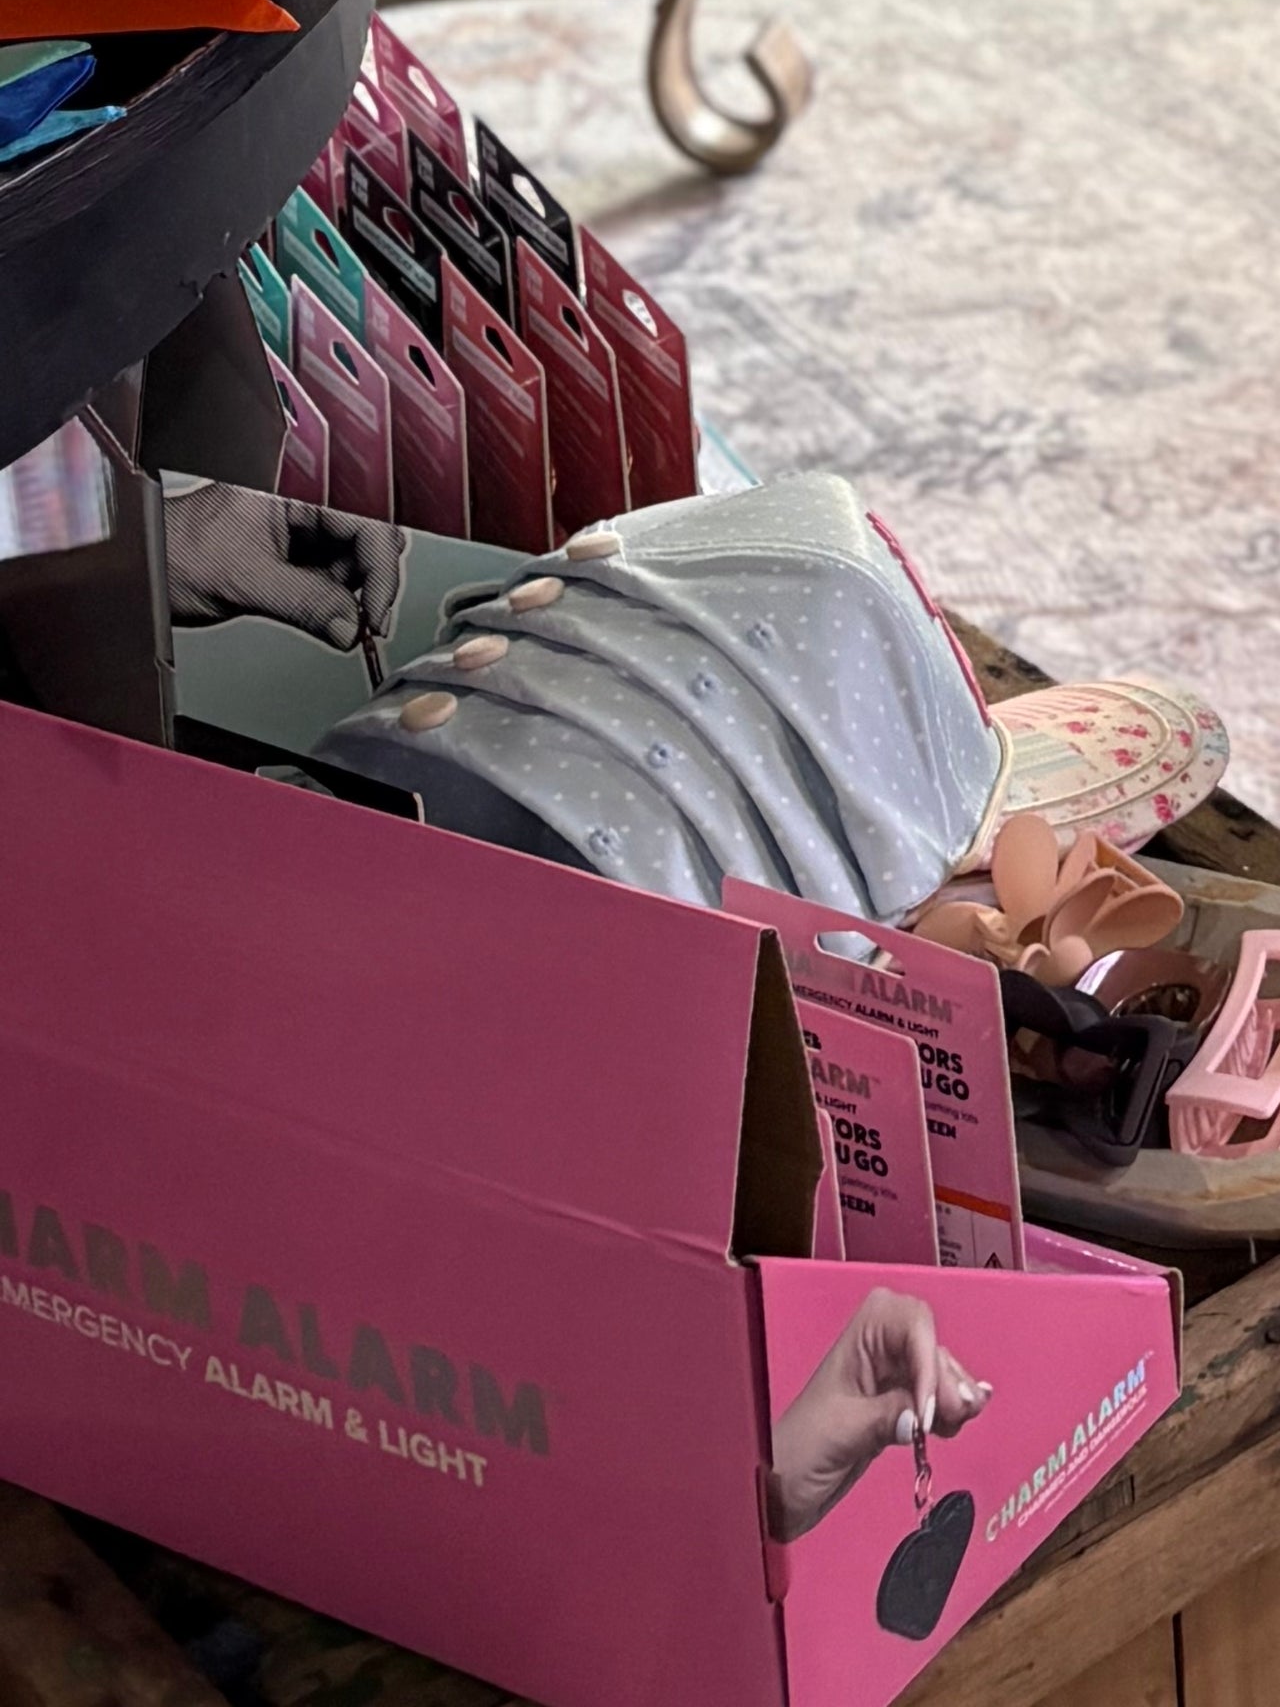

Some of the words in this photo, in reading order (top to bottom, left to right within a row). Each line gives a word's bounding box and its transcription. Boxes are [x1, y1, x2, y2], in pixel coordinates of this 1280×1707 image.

[792, 983, 853, 1011] MERGENCY
[855, 1003, 894, 1024] ALARM
[907, 1020, 940, 1039] LIGHT
[860, 972, 954, 1024] ALARM
[811, 1056, 872, 1100] ARM
[917, 1042, 964, 1075] ORS
[824, 1096, 858, 1115] LIGHT
[935, 1073, 969, 1101] GO
[832, 1116, 883, 1151] ORS
[927, 1118, 957, 1139] EEN
[854, 1149, 889, 1177] GO
[0, 1192, 214, 1334] ARM
[238, 1283, 551, 1457] ALARM
[0, 1273, 193, 1372] MERGENCY
[203, 1354, 335, 1430] ALARM
[343, 1407, 370, 1445] &
[377, 1418, 489, 1488] LIGHT
[984, 1439, 1068, 1542] CHARM
[1070, 1357, 1147, 1458] ALARM
